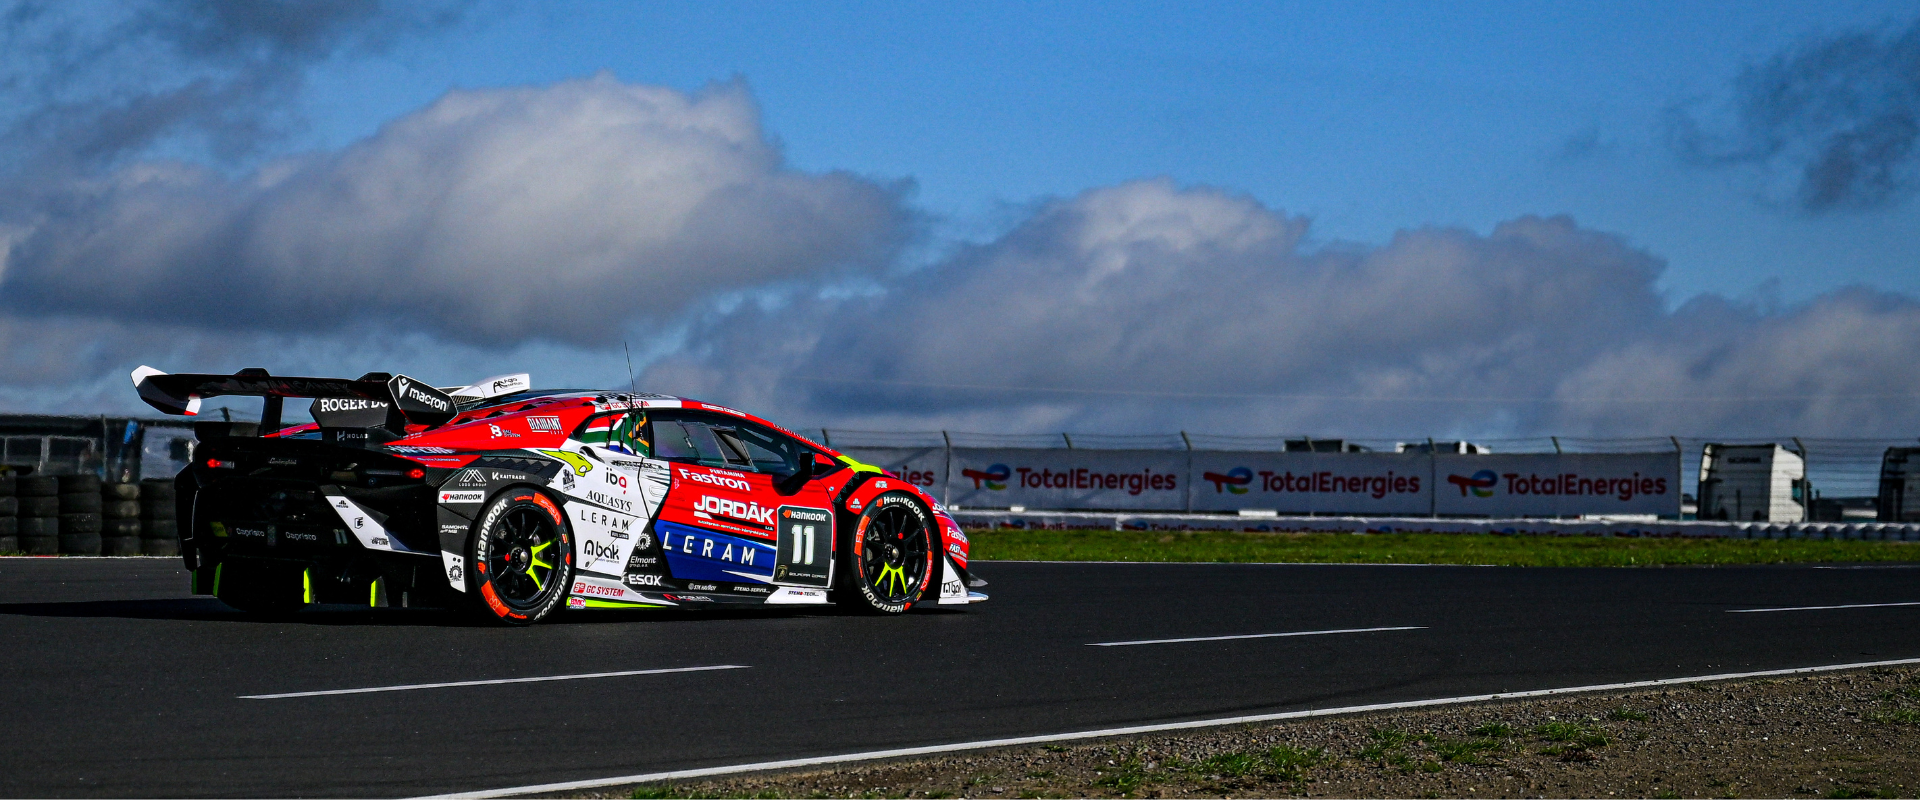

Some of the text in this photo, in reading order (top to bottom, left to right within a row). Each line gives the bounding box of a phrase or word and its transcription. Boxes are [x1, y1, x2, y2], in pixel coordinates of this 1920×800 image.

[320, 398, 367, 412] ROGER
[408, 386, 447, 412] macron
[678, 468, 751, 491] Fastron
[709, 468, 746, 479] PERTAMINA
[1016, 466, 1177, 496] TotalEnergies
[1258, 471, 1420, 499] TotalEnergies
[1503, 472, 1667, 501] TotalEnergies
[586, 490, 633, 512] AQUASYS
[581, 509, 629, 531] LERAM
[235, 527, 265, 538] Capristo
[285, 531, 317, 541] Capristo
[333, 528, 348, 545] 11
[946, 526, 969, 546] Fastron
[662, 531, 756, 566] LERAM
[791, 524, 815, 565] 11
[630, 555, 657, 564] Elmont
[585, 584, 625, 598] GC SYSTEM
[570, 598, 585, 606] BMC
